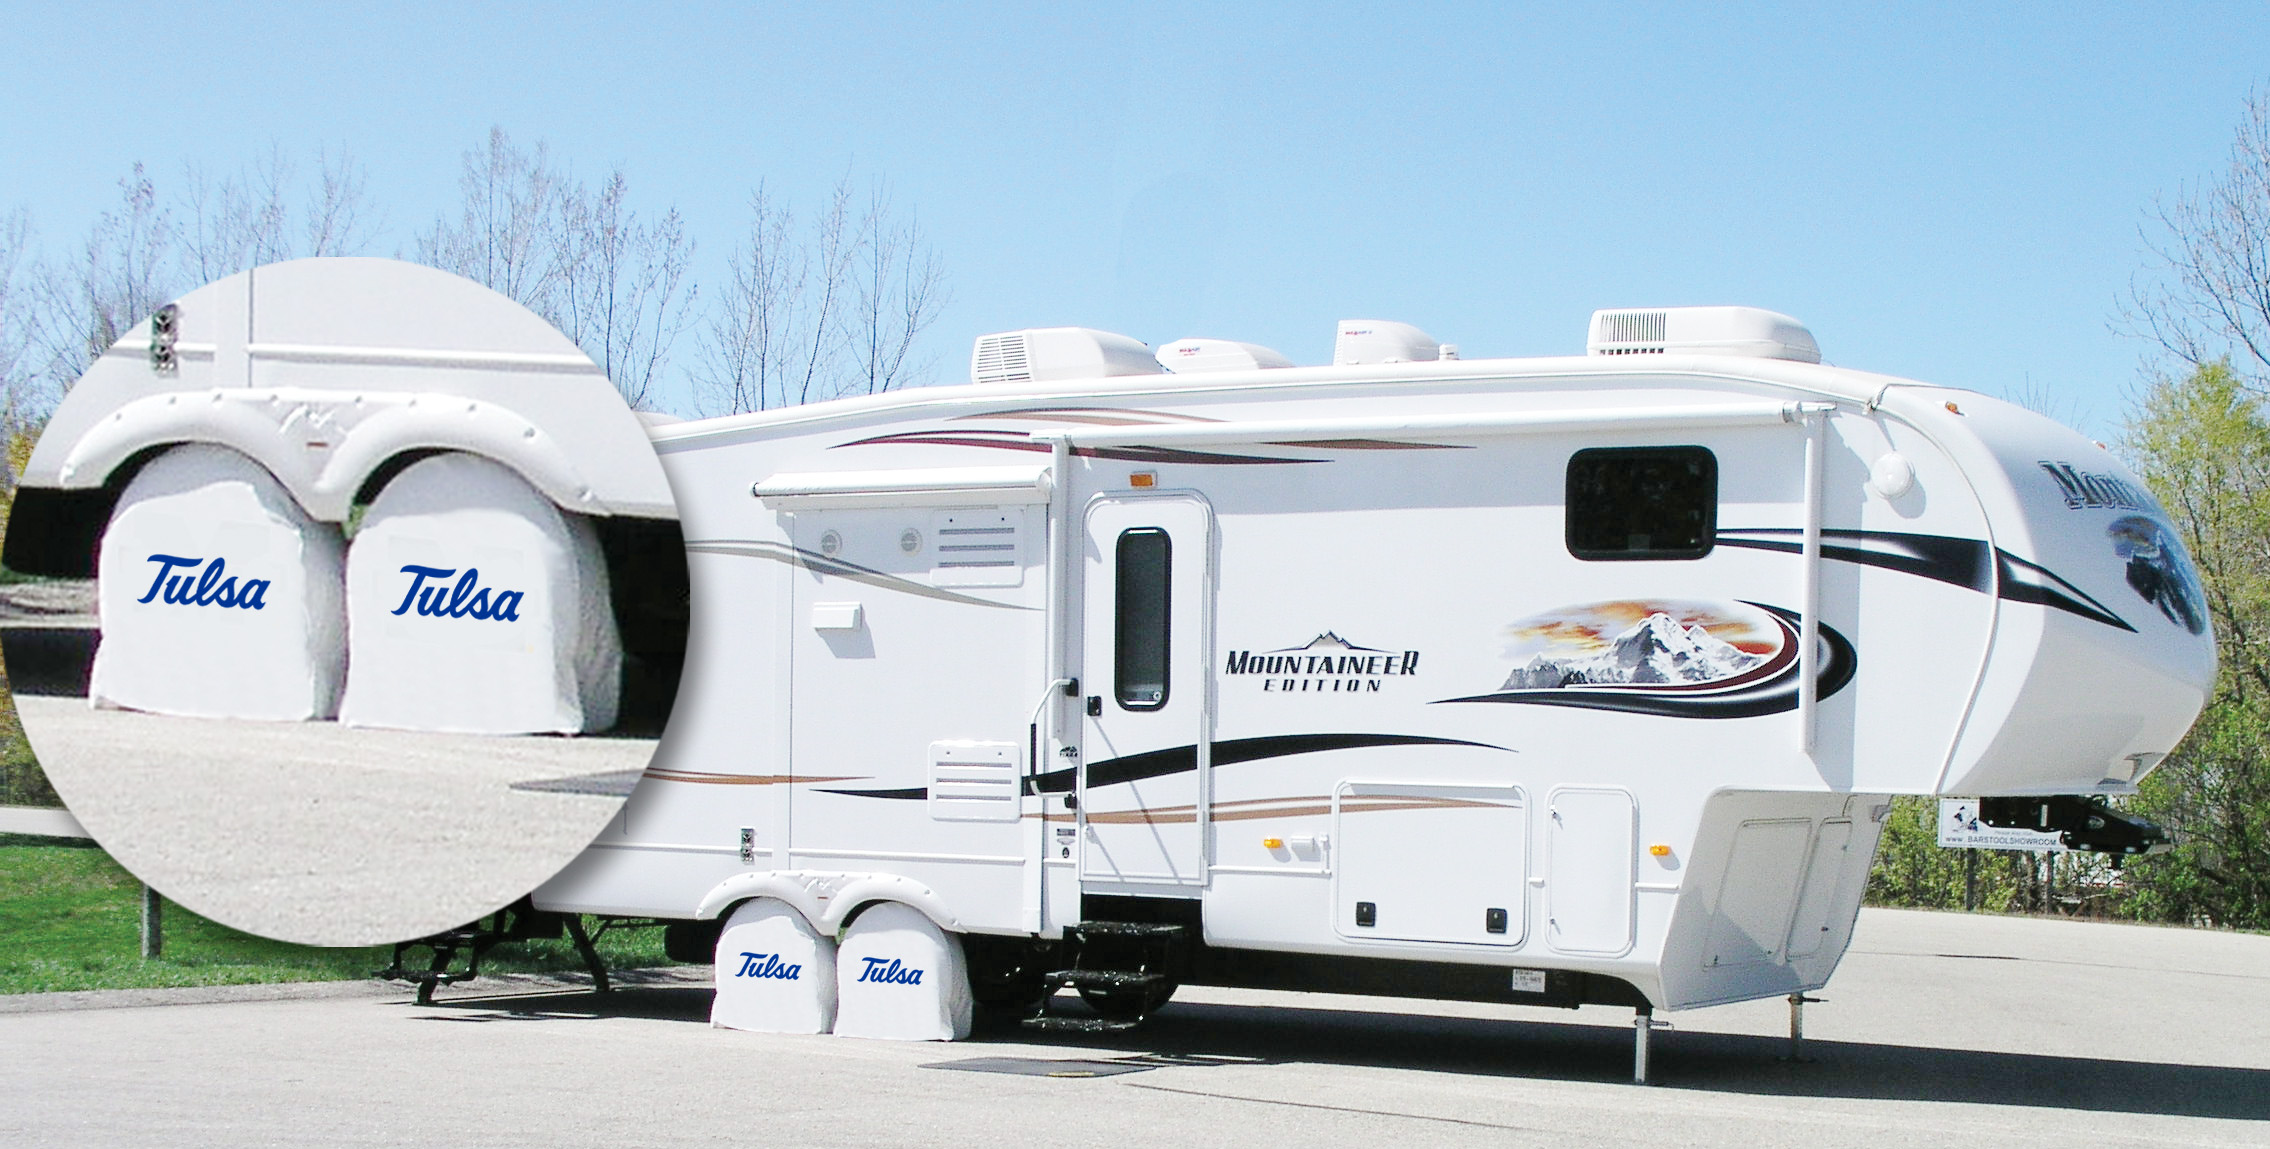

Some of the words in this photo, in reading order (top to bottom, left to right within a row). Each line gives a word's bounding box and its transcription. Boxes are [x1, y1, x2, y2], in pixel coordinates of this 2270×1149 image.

[137, 554, 271, 611] Tulsa
[391, 564, 525, 622] Tulsa
[1225, 650, 1419, 676] MOUNTAINEER
[1263, 678, 1381, 692] EDITION
[735, 951, 803, 981] Tulsa
[856, 956, 924, 986] Tulsa
